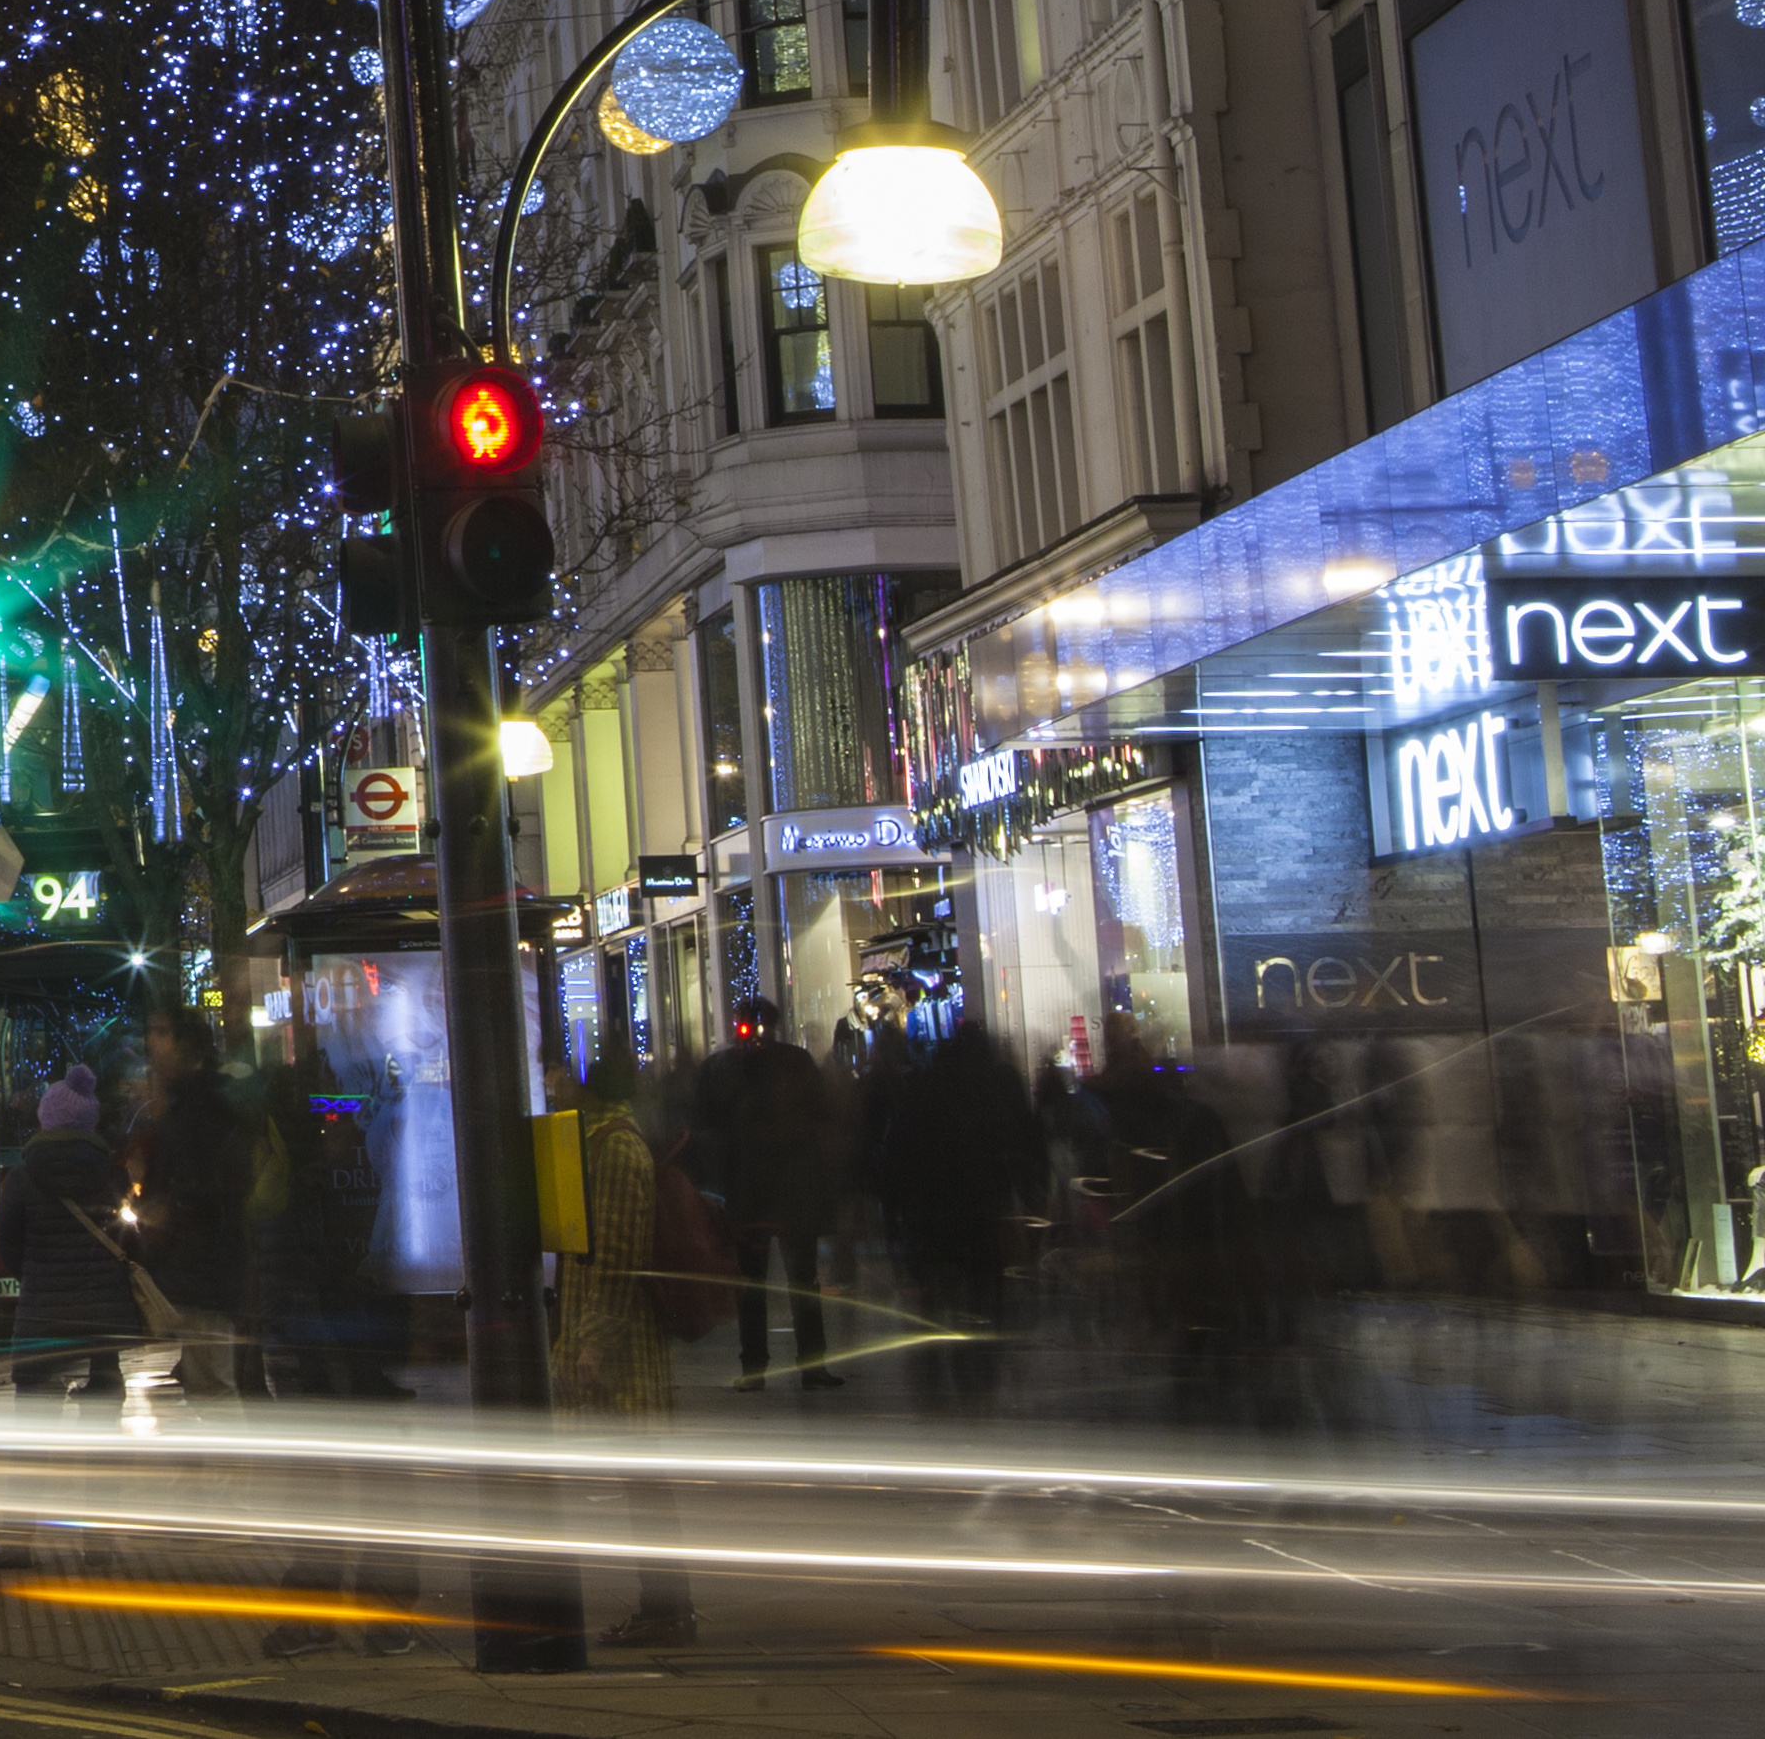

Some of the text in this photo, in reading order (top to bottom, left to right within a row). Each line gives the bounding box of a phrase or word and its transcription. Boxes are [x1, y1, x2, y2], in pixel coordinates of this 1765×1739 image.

[1454, 51, 1605, 270] next
[1505, 594, 1748, 666] next
[1398, 710, 1513, 851] next
[780, 817, 917, 853] Massimo Du
[33, 876, 97, 922] 94
[1254, 951, 1449, 1009] next
